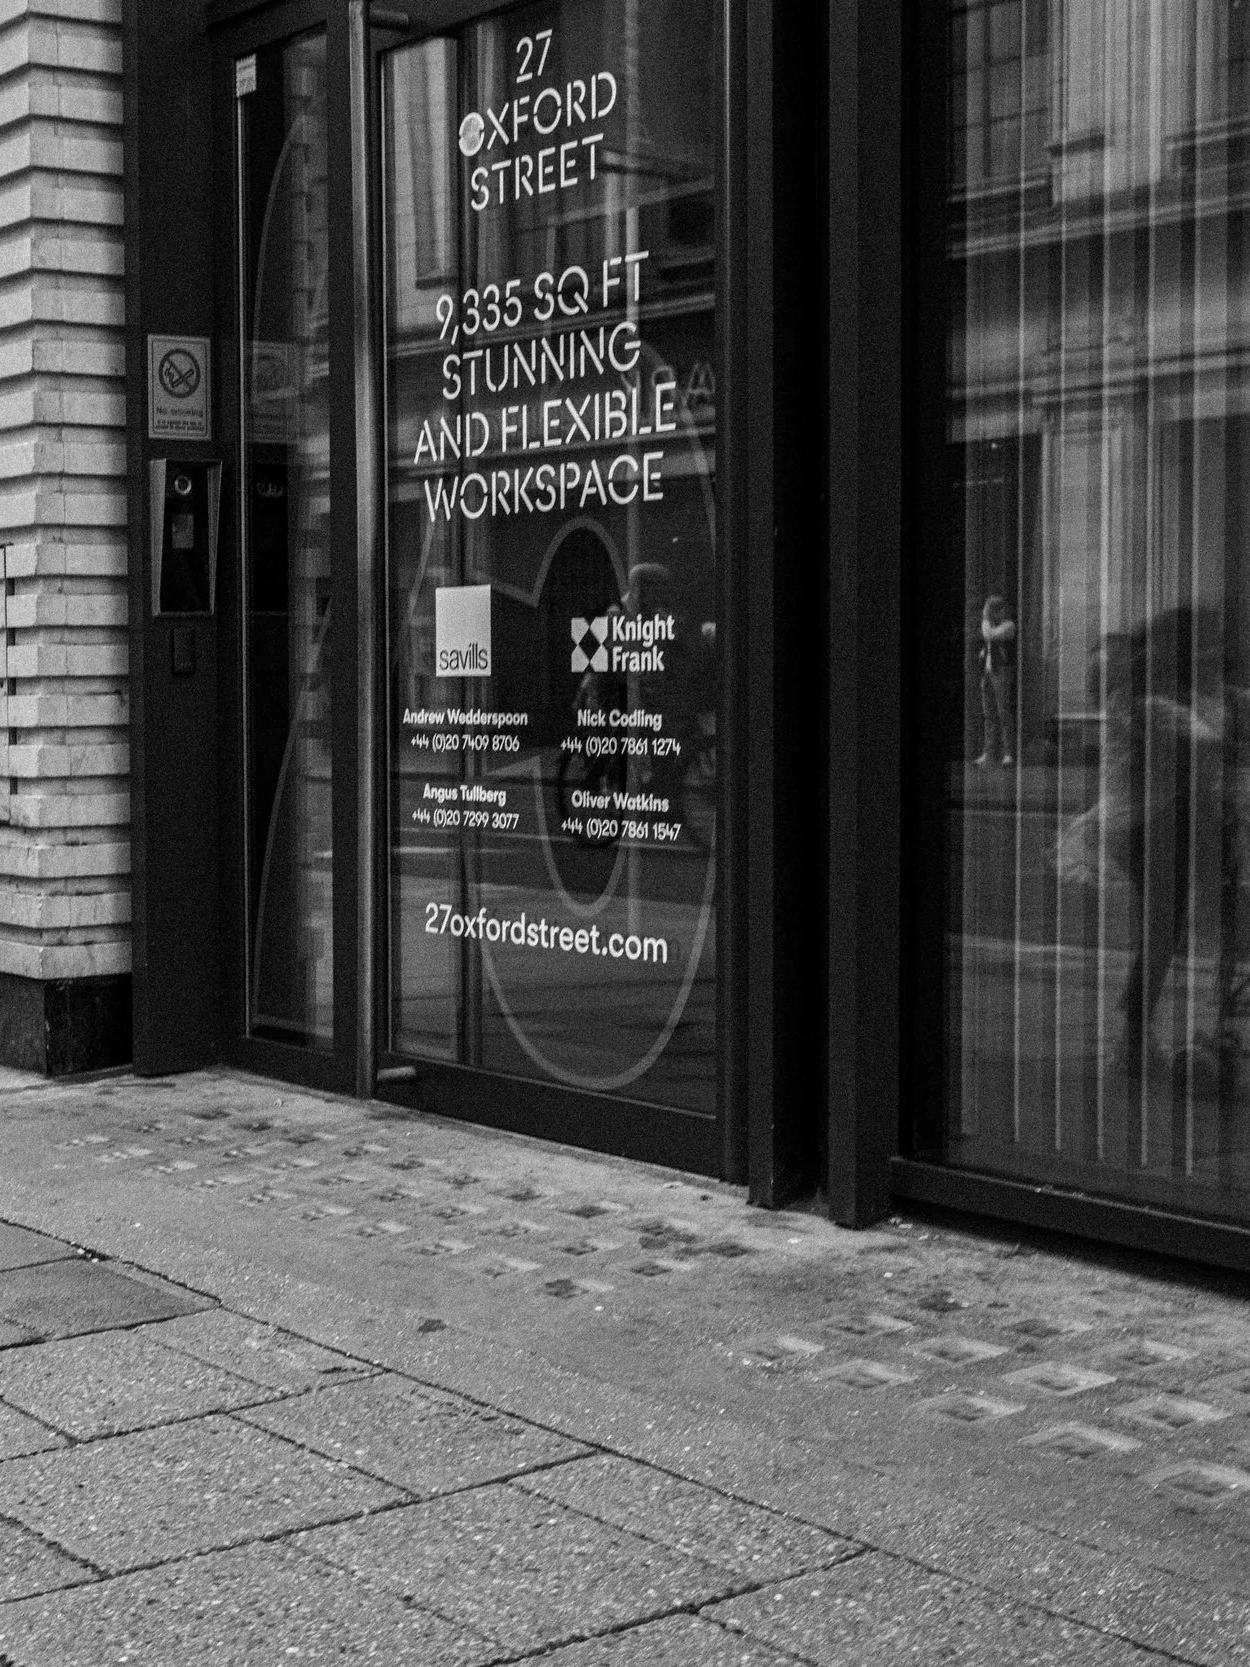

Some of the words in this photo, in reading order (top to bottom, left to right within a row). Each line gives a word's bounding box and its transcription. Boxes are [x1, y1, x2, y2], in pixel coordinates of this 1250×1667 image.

[515, 29, 553, 84] 27
[458, 71, 617, 157] OXFORD
[470, 133, 604, 211] STREET
[436, 279, 523, 346] 9,335
[533, 265, 589, 321] SQ
[602, 251, 650, 308] FT
[442, 321, 642, 401] STUNNING
[414, 412, 490, 465] AND
[501, 381, 677, 453] FLEXIBLE
[424, 451, 664, 522] WORKSPACE
[612, 614, 675, 648] Knight
[439, 643, 488, 670] savills
[612, 645, 665, 672] Frank
[403, 708, 445, 725] Andrew
[447, 709, 528, 729] Wedderspoon
[577, 709, 606, 727] Nick
[608, 709, 663, 732] Codling
[411, 734, 430, 750] +44
[432, 734, 460, 753] (0)20
[462, 735, 490, 751] 7409
[492, 735, 520, 752] 8706
[560, 736, 583, 753] +44
[585, 737, 617, 758] (0)20
[620, 737, 648, 756] 7861
[652, 738, 681, 757] 1274
[423, 783, 458, 803] Angus
[460, 785, 507, 807] Tullberg
[571, 790, 611, 810] Oliver
[613, 792, 670, 813] Watkins
[412, 810, 431, 825] +44
[433, 810, 460, 828] (0)20
[462, 812, 490, 828] 7299
[491, 813, 519, 830] 3077
[561, 818, 583, 836] +44
[586, 820, 618, 840] (0)20
[621, 820, 649, 840] 7861
[652, 822, 682, 842] 1547
[425, 902, 669, 964] 27oxfordstreet.com
